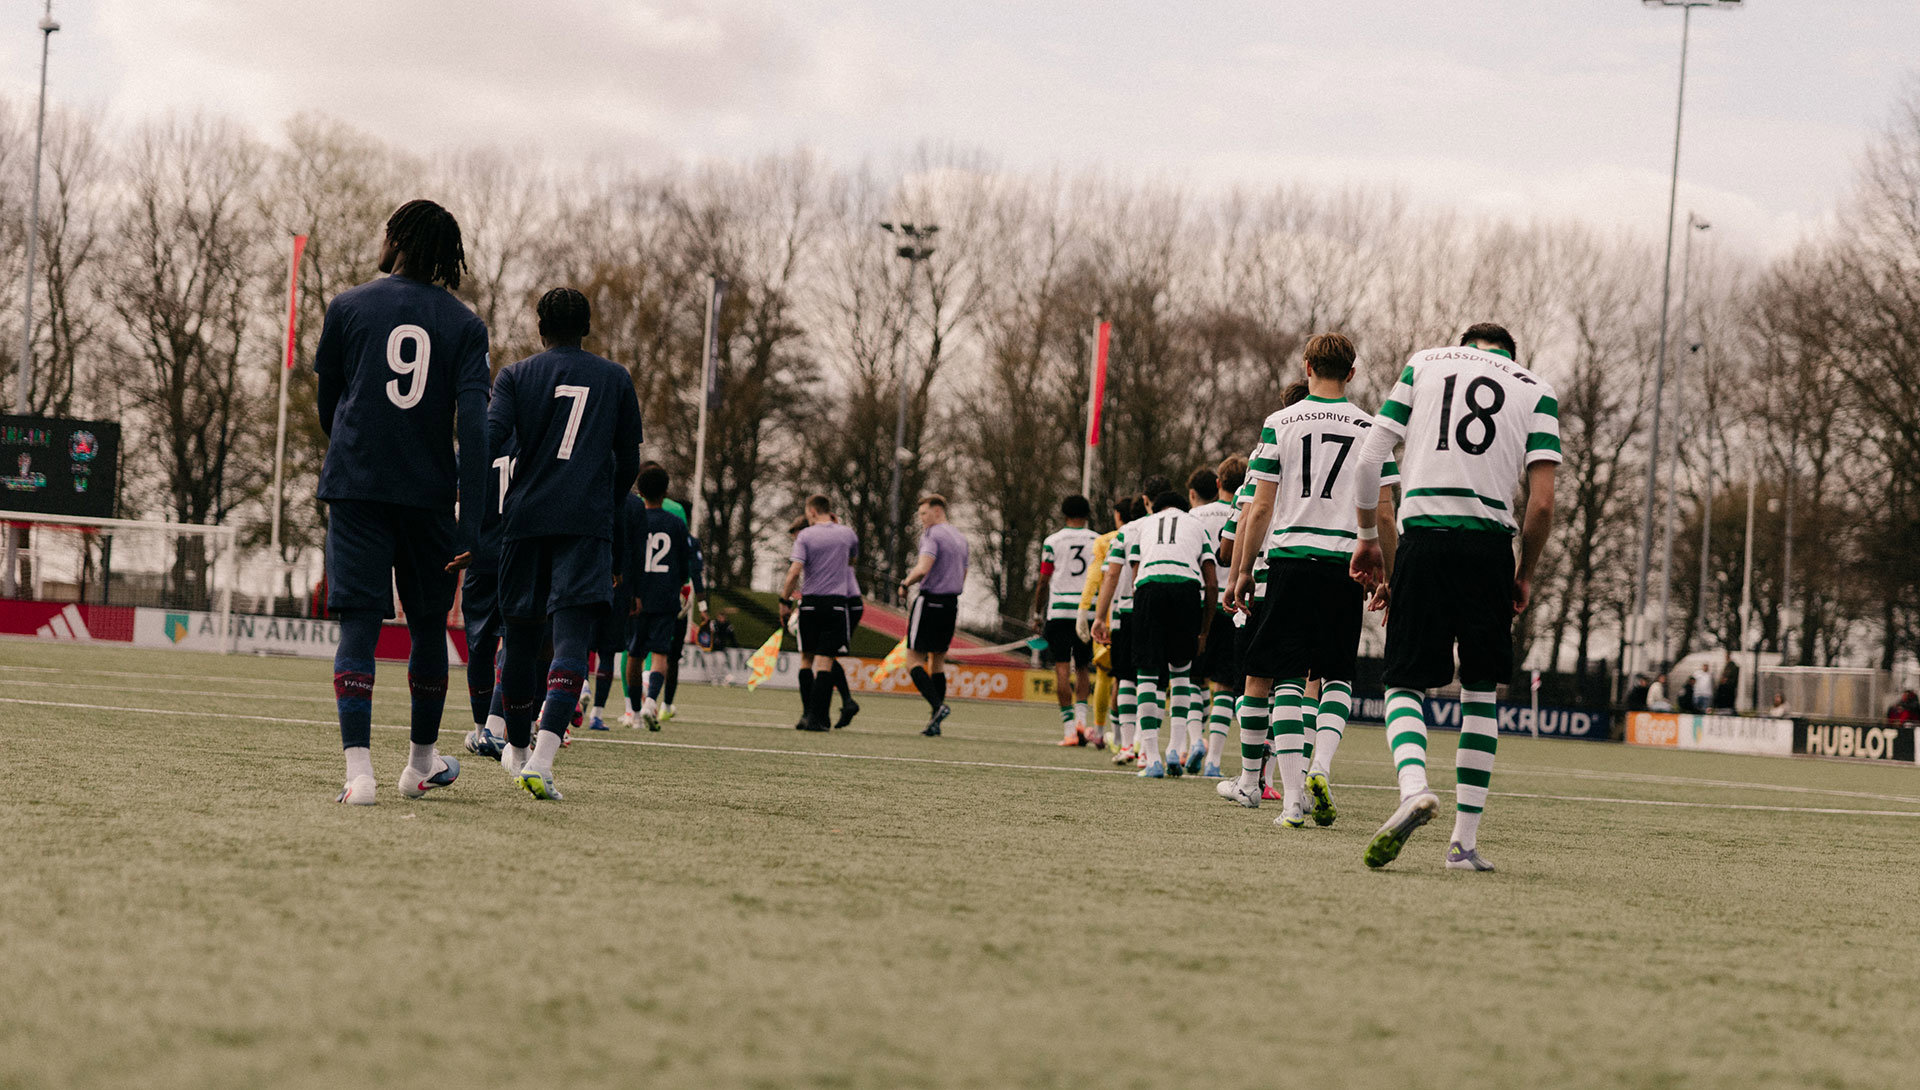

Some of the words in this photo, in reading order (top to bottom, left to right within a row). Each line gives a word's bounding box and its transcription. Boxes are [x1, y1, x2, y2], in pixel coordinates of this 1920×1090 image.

[386, 324, 431, 409] 9
[554, 384, 590, 461] 7
[1281, 412, 1350, 425] GLASSDRIVE
[1435, 373, 1506, 456] 18
[492, 455, 517, 515] 1
[1300, 432, 1355, 499] 17
[644, 532, 672, 573] 12
[1156, 516, 1179, 545] 11
[1070, 545, 1086, 576] 3
[1806, 724, 1898, 759] HUBLOT
